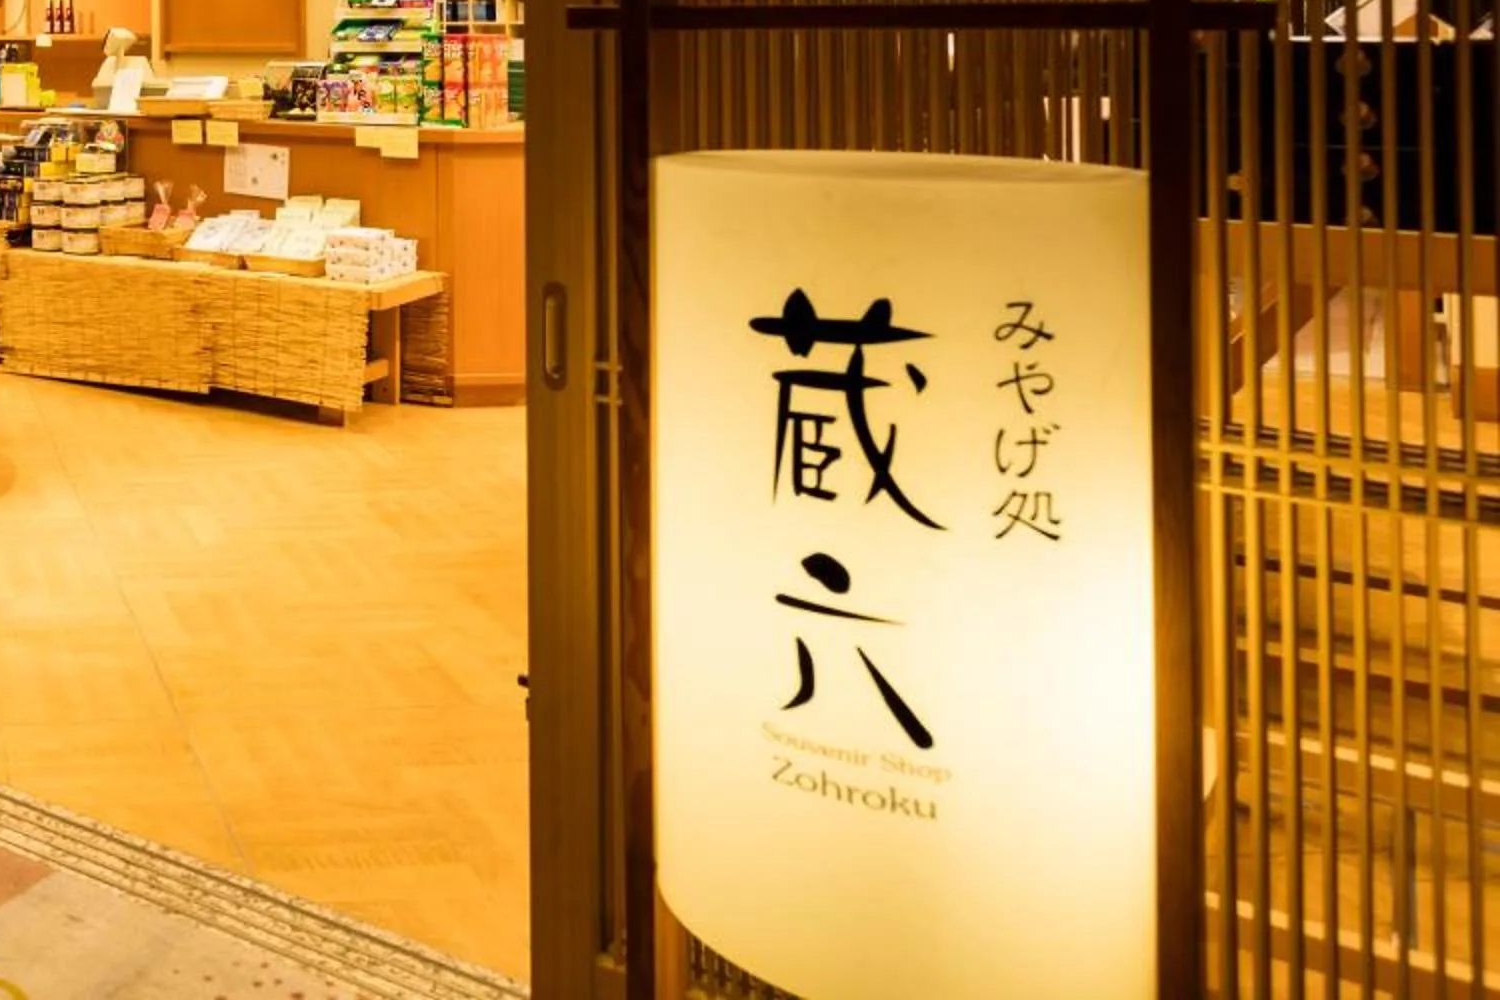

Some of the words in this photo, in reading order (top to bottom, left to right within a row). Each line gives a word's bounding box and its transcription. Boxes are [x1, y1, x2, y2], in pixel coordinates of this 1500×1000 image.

[992, 299, 1062, 542] みやげ処
[748, 286, 950, 750] 蔵六
[761, 720, 870, 768] Souvenir
[878, 752, 953, 786] Shop
[771, 754, 938, 820] Zohroku
